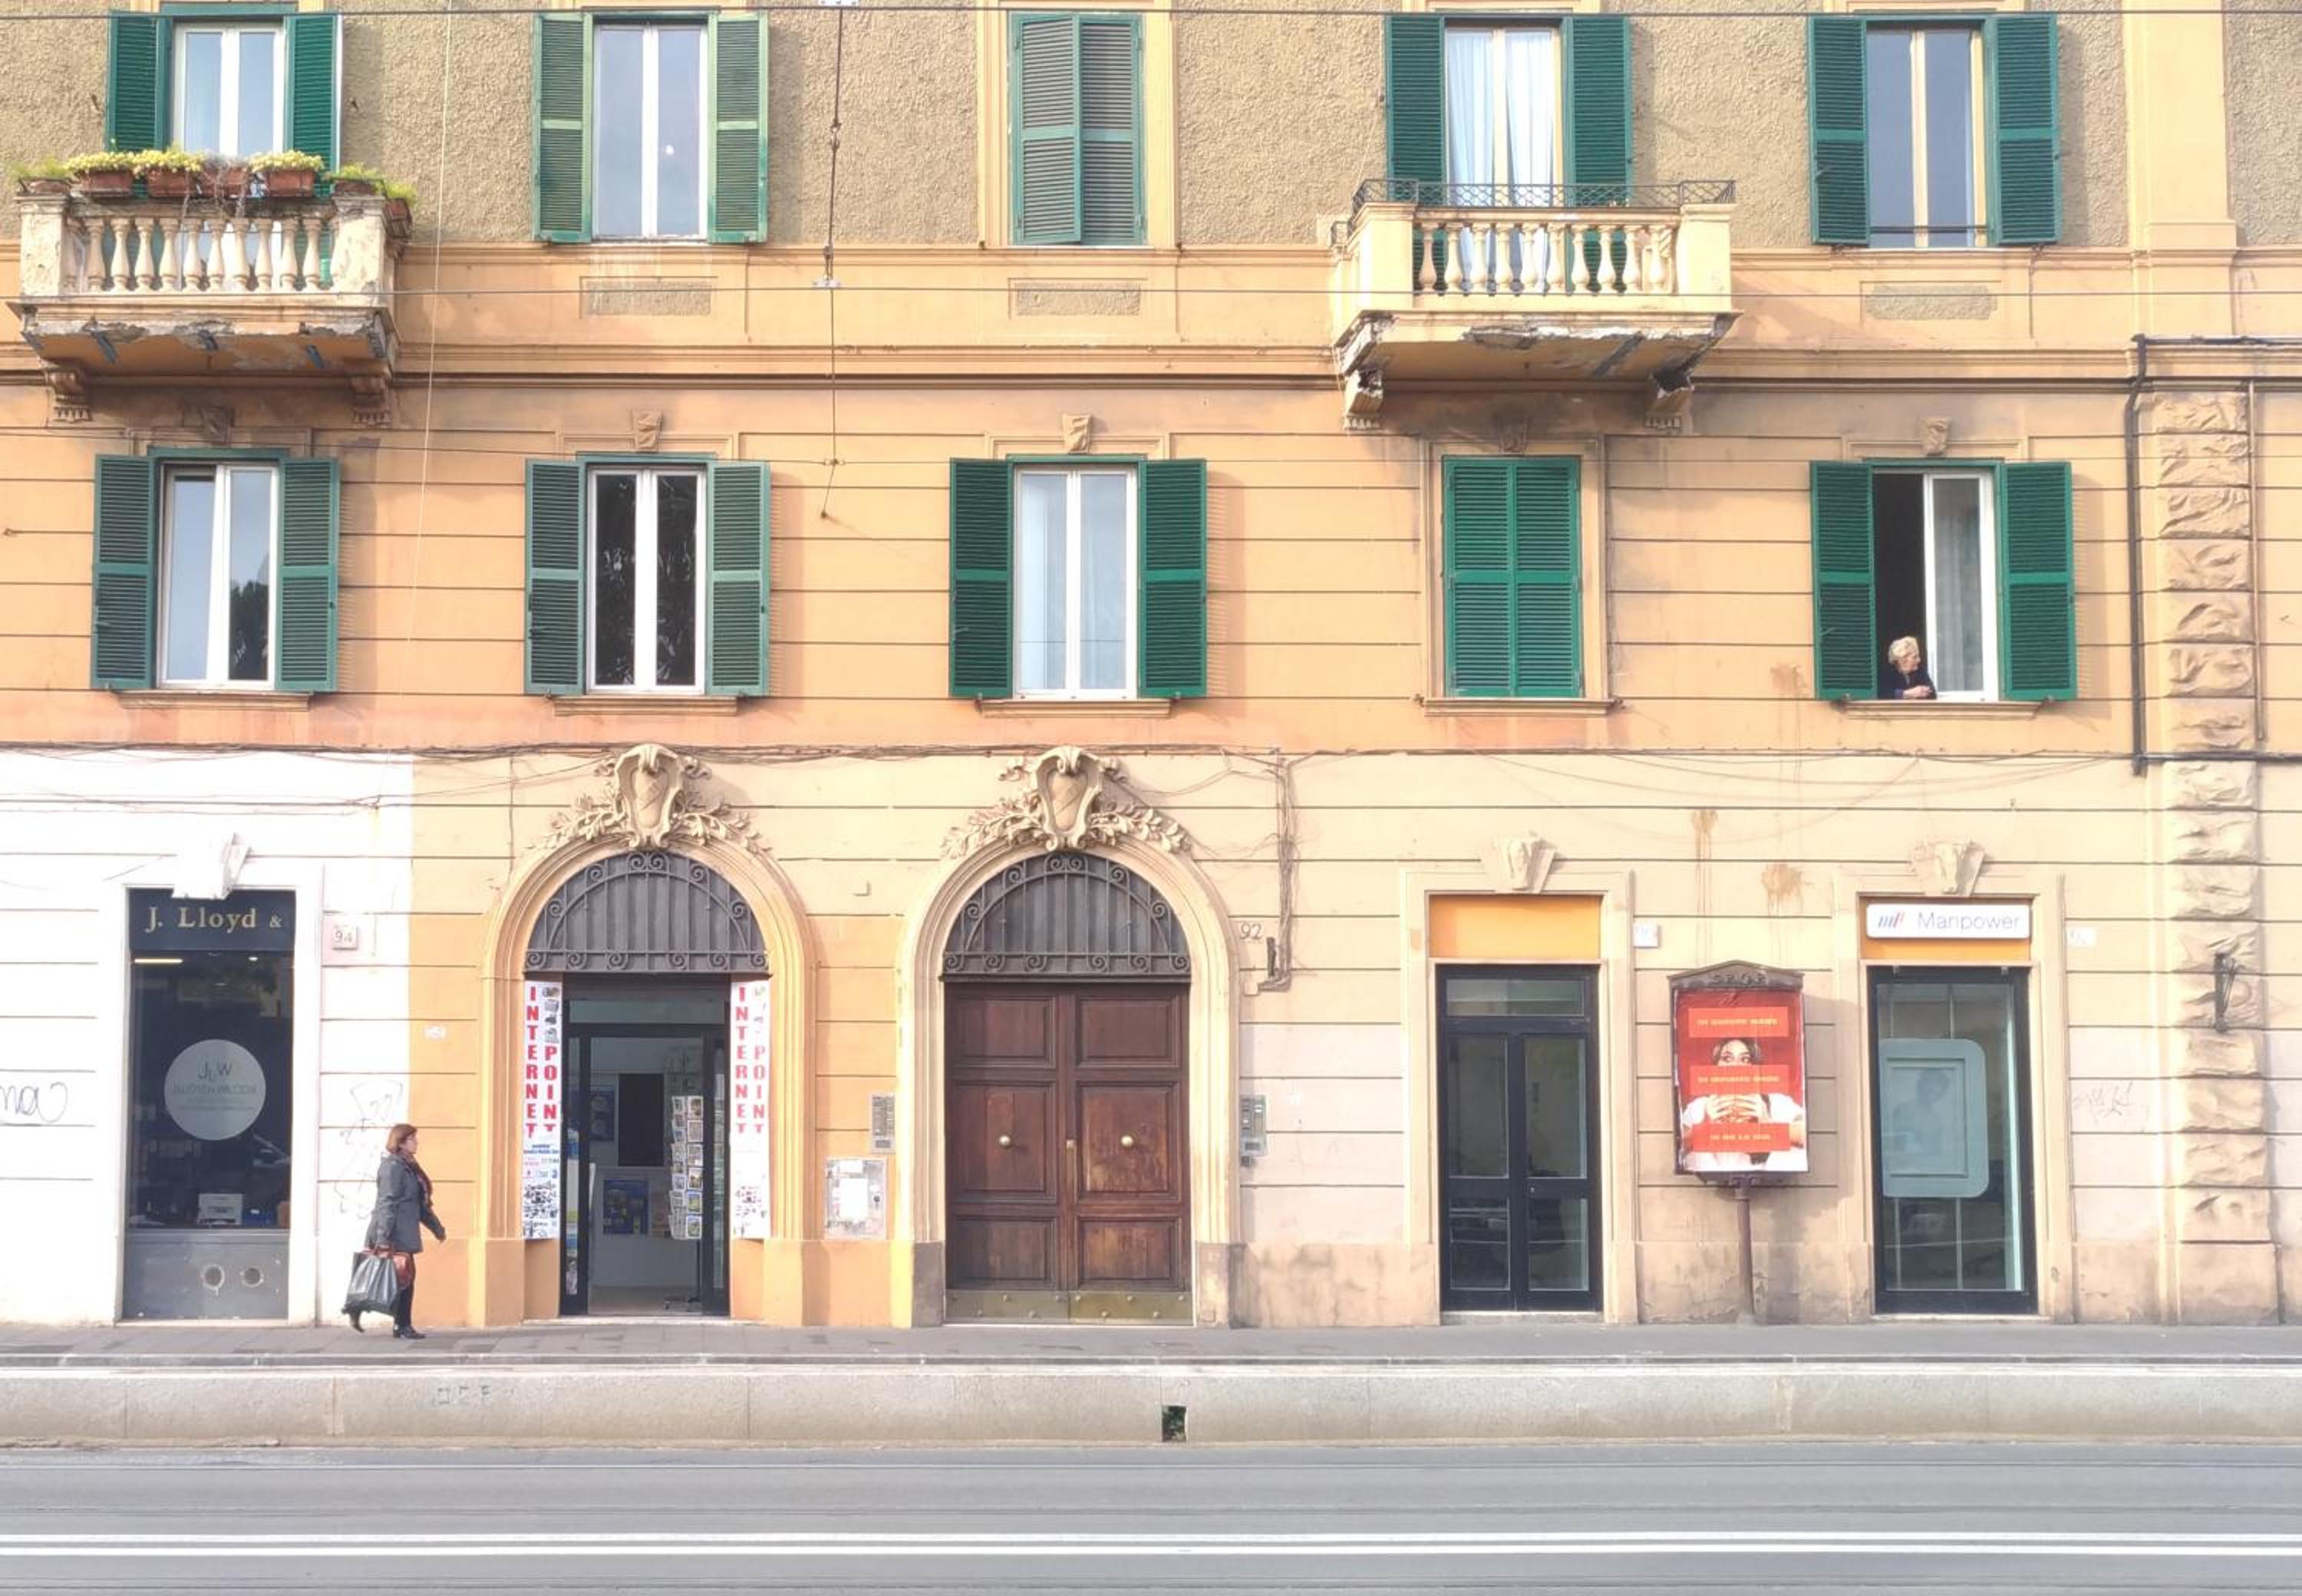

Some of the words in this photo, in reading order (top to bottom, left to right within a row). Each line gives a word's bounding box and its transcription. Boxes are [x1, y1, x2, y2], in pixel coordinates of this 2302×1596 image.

[144, 906, 163, 933] J.
[178, 907, 258, 933] Lloyd
[269, 914, 282, 928] &
[1239, 922, 1262, 940] 92
[1918, 912, 2020, 931] Manpower
[526, 986, 539, 1139] INTERNET
[543, 1046, 557, 1132] POINT
[735, 986, 749, 1133] INTERNET
[753, 1045, 766, 1133] POINT
